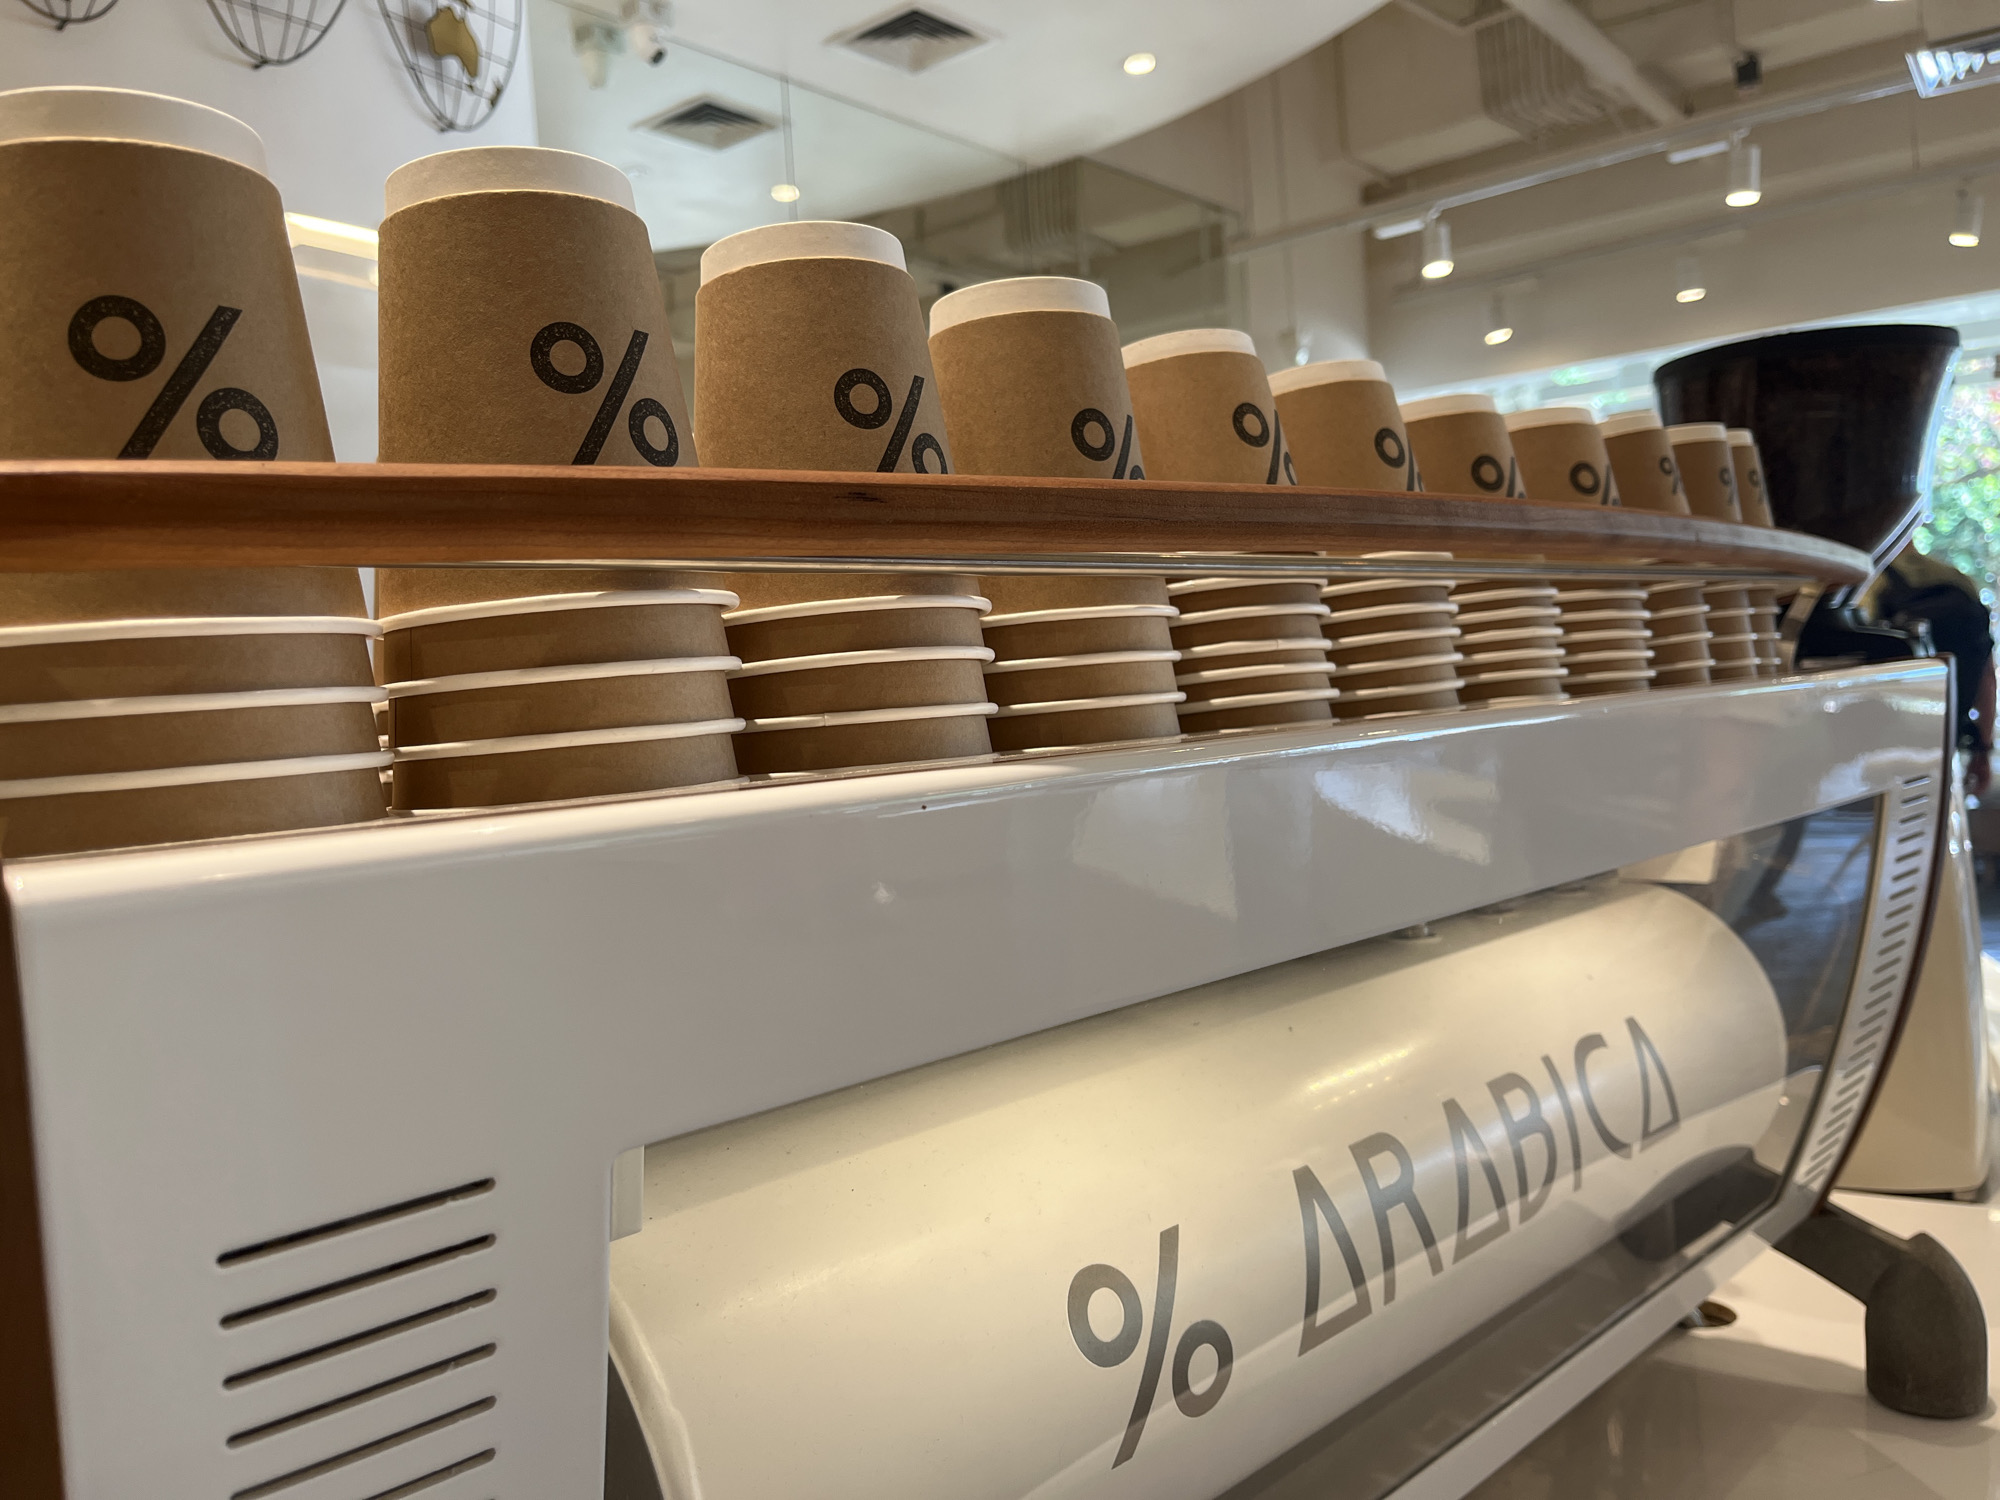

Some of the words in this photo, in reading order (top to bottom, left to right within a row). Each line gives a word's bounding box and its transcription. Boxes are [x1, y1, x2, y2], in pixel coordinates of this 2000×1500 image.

[68, 295, 279, 461] %
[530, 322, 679, 467] %
[834, 368, 948, 475] %
[1067, 1224, 1234, 1470] %
[1292, 1016, 1680, 1357] ARABICA
